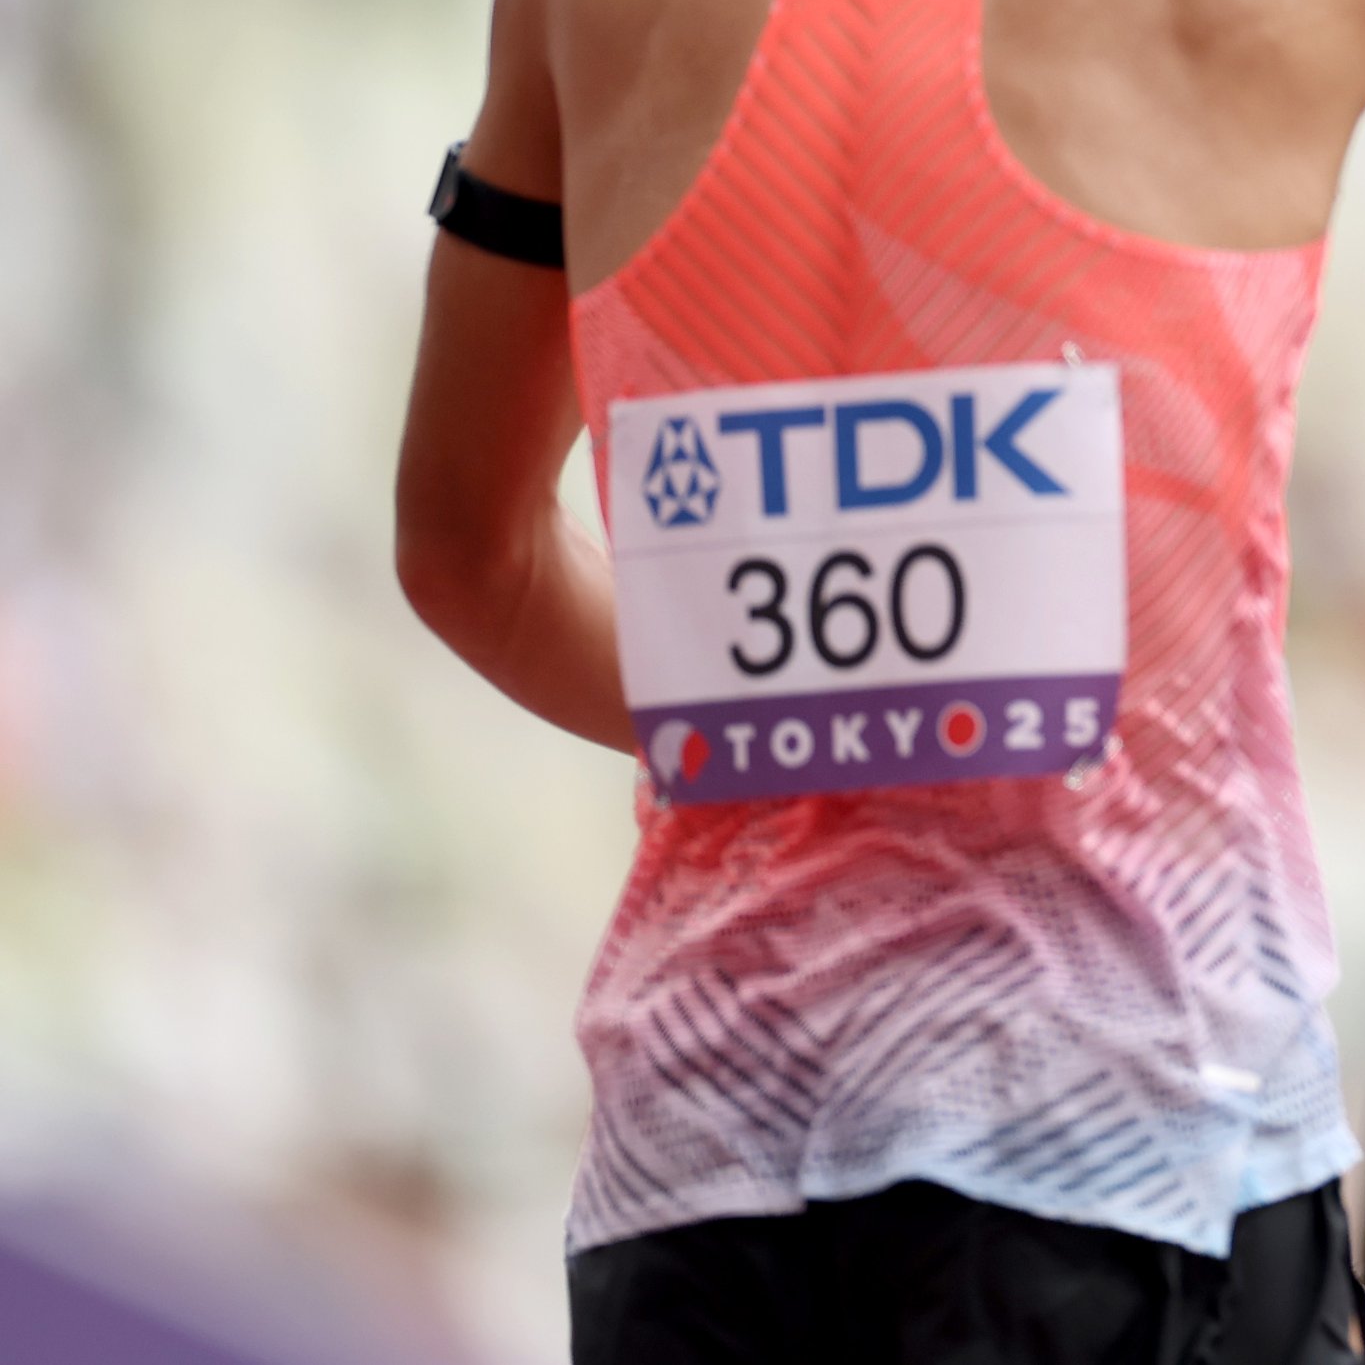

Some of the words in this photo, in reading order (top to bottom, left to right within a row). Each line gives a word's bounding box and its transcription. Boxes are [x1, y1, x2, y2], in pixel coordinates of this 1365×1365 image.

[716, 388, 1071, 518] TDK
[727, 543, 965, 677] 360
[723, 700, 986, 772] TOKYO
[1003, 698, 1099, 750] 25
